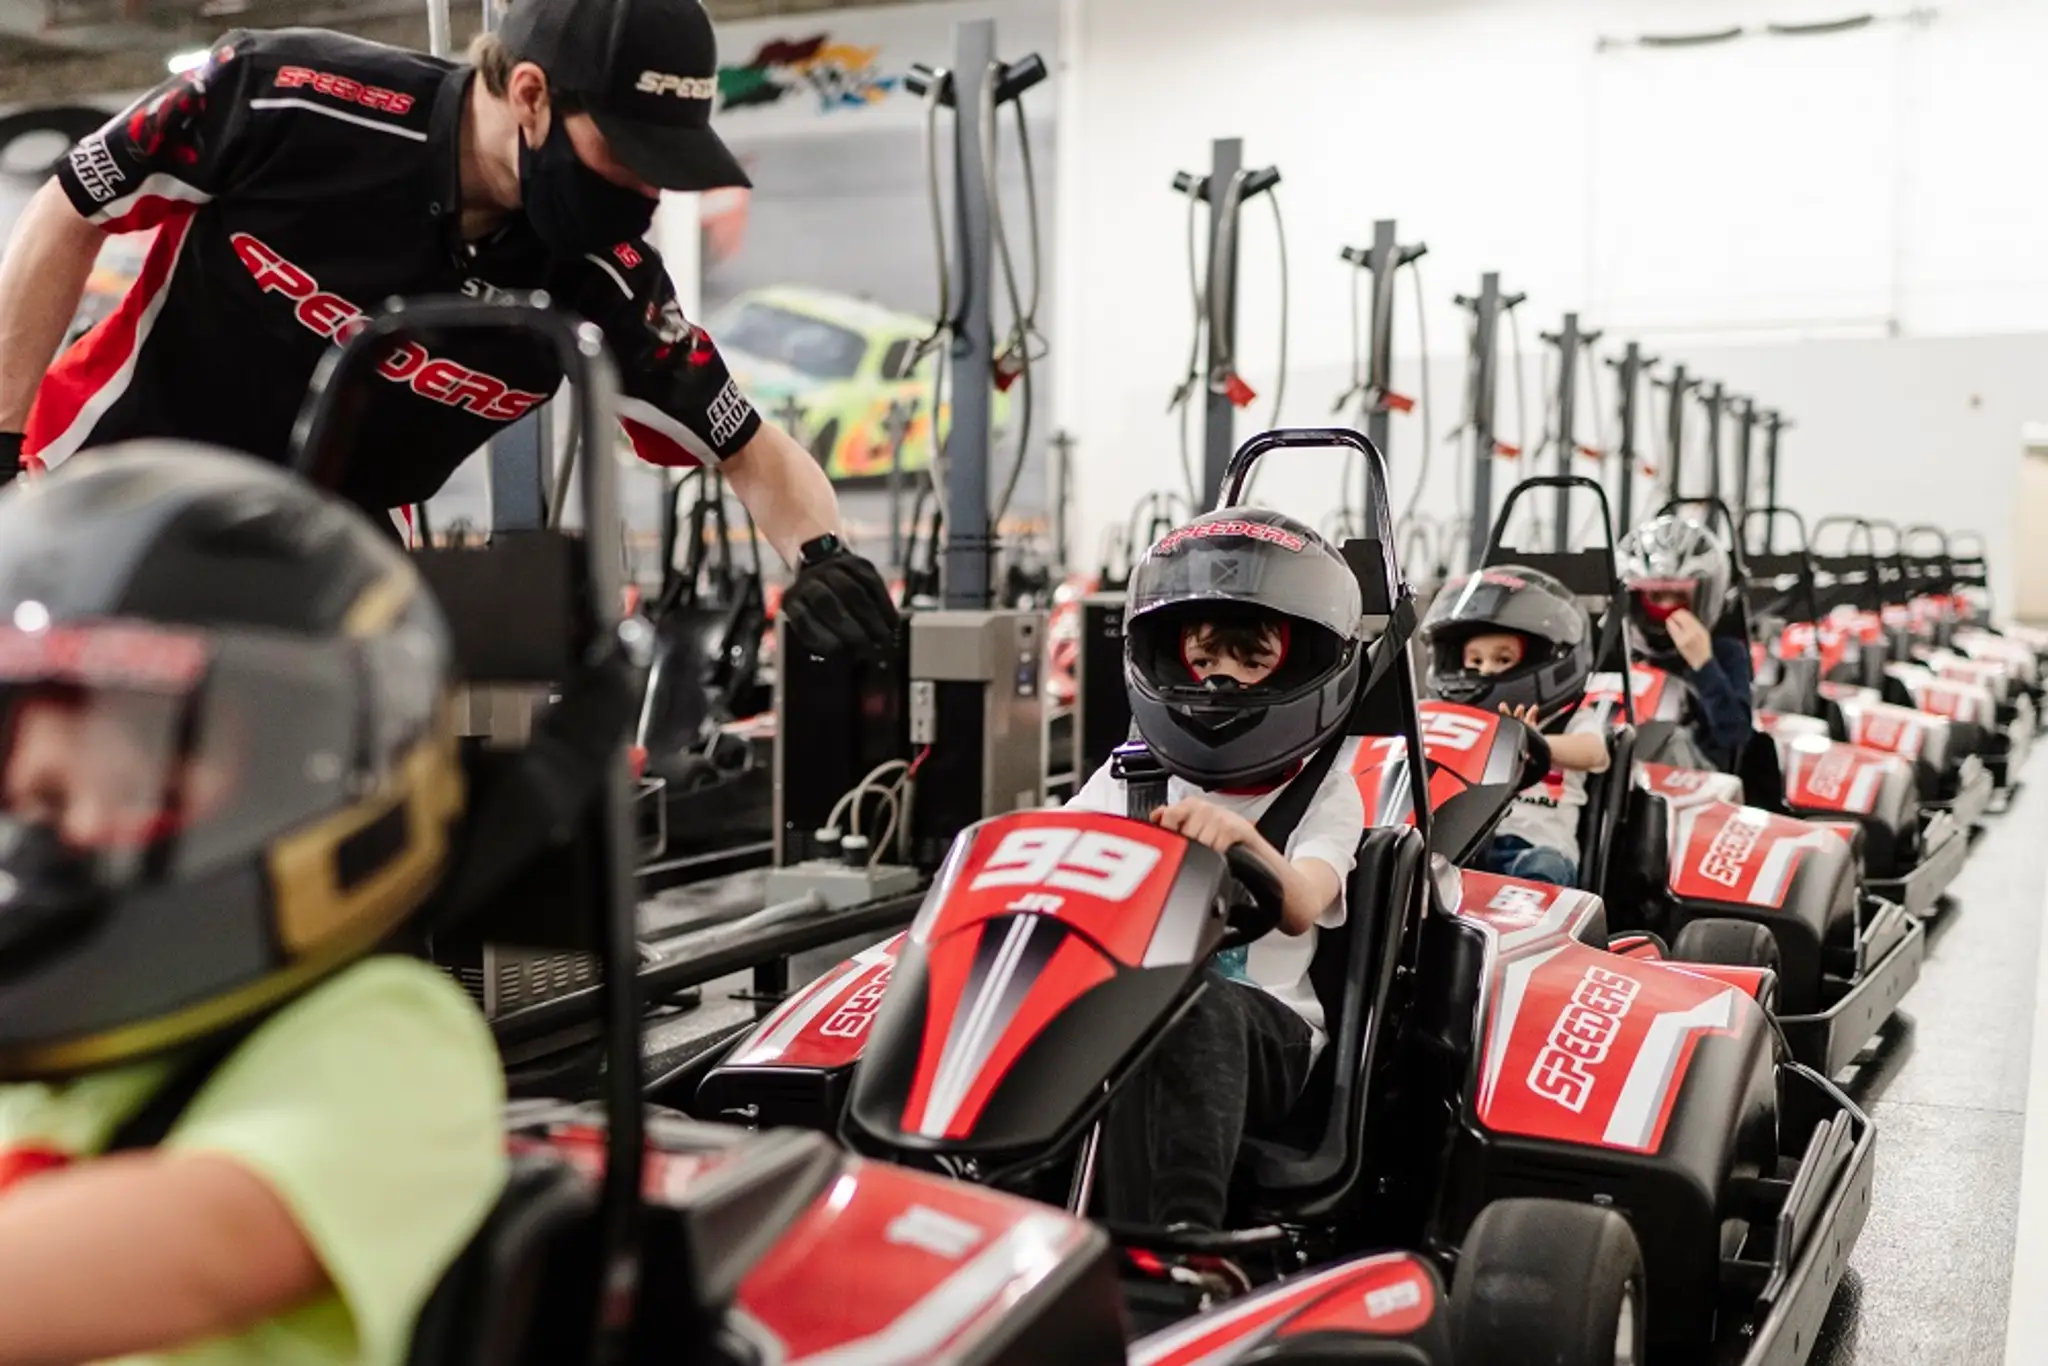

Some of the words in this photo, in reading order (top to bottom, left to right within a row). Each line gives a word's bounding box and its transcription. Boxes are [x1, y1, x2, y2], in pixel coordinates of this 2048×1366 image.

[274, 65, 416, 116] SPEEDERS
[1157, 519, 1306, 553] SPEEDERS
[969, 827, 1163, 902] 99
[1526, 965, 1642, 1114] SPEEDERS
